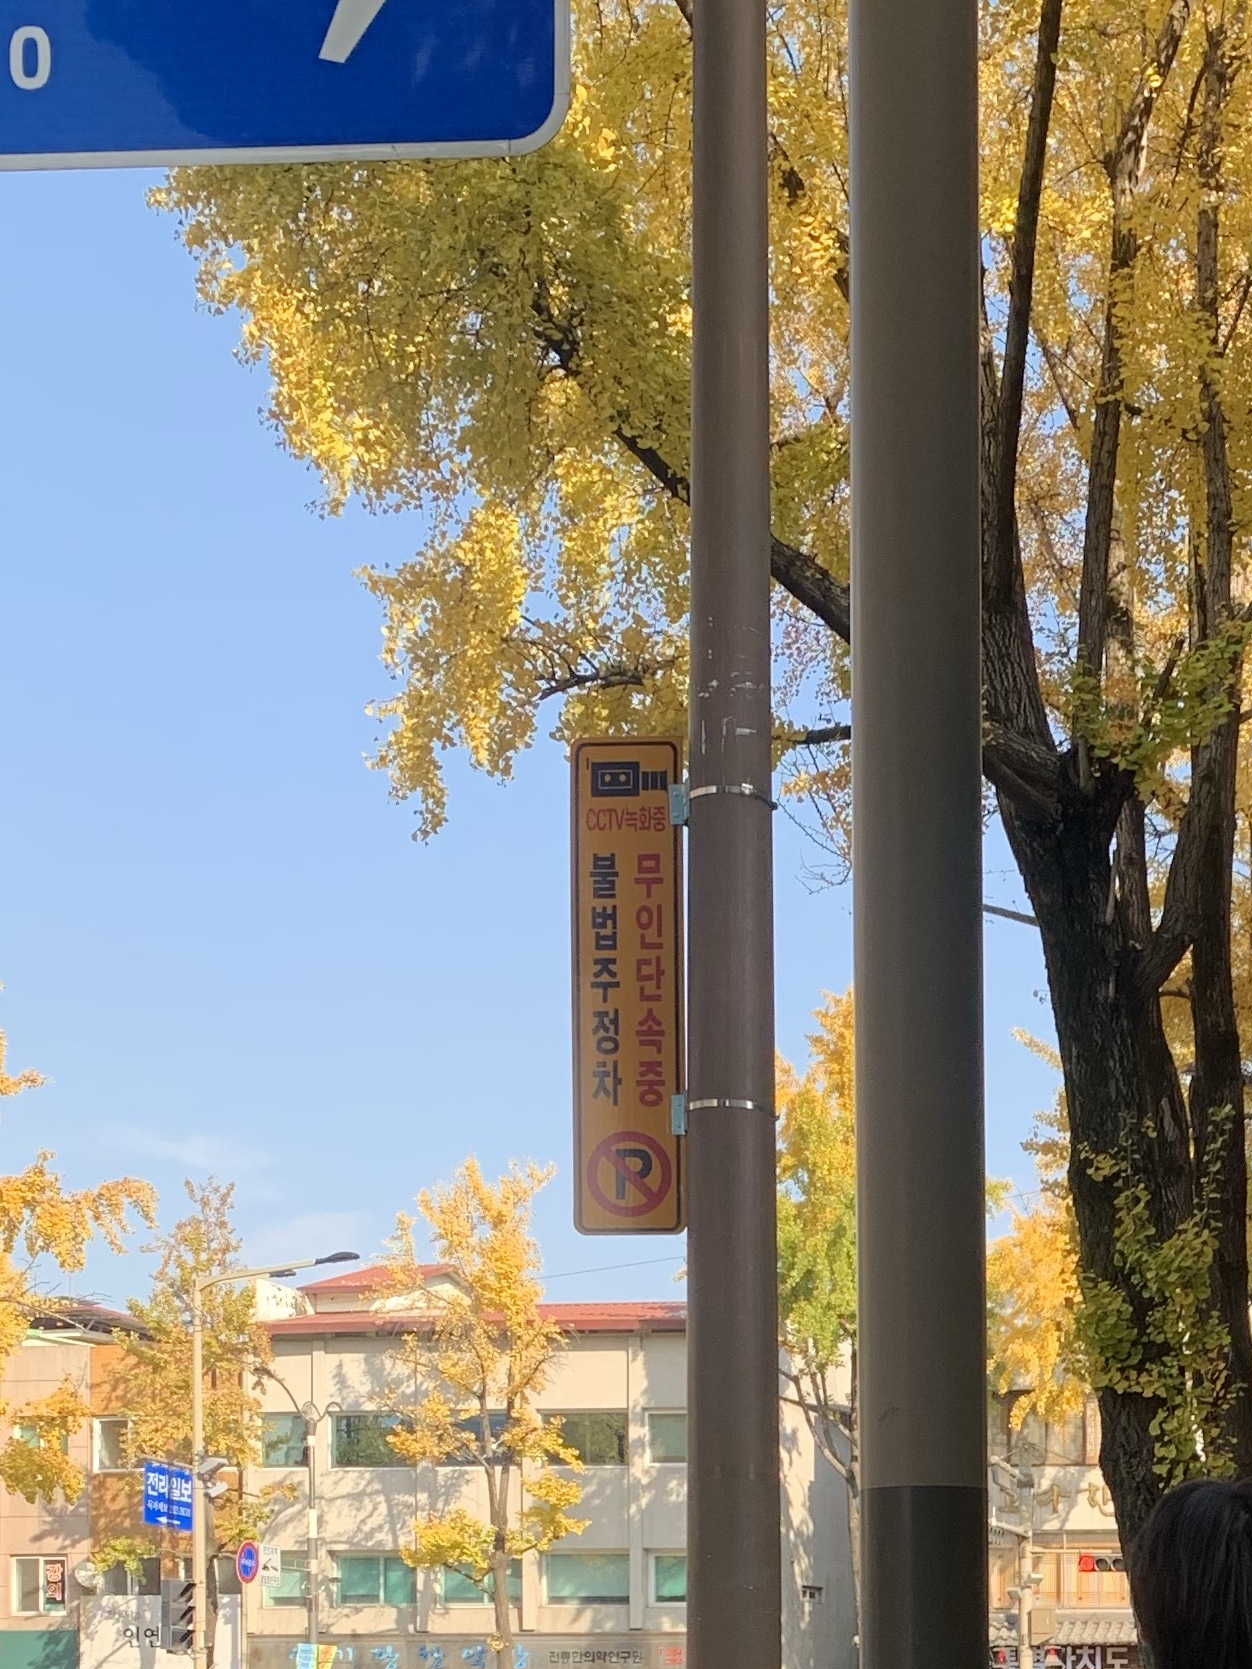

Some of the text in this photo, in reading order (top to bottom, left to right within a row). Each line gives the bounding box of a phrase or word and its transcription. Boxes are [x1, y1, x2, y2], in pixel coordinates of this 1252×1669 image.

[587, 806, 667, 833] CCTV녹화중
[589, 853, 622, 1106] 불법주정차
[634, 853, 665, 1108] 무인단속중
[614, 1147, 653, 1201] P
[549, 1650, 644, 1664] 전통한의약연구원
